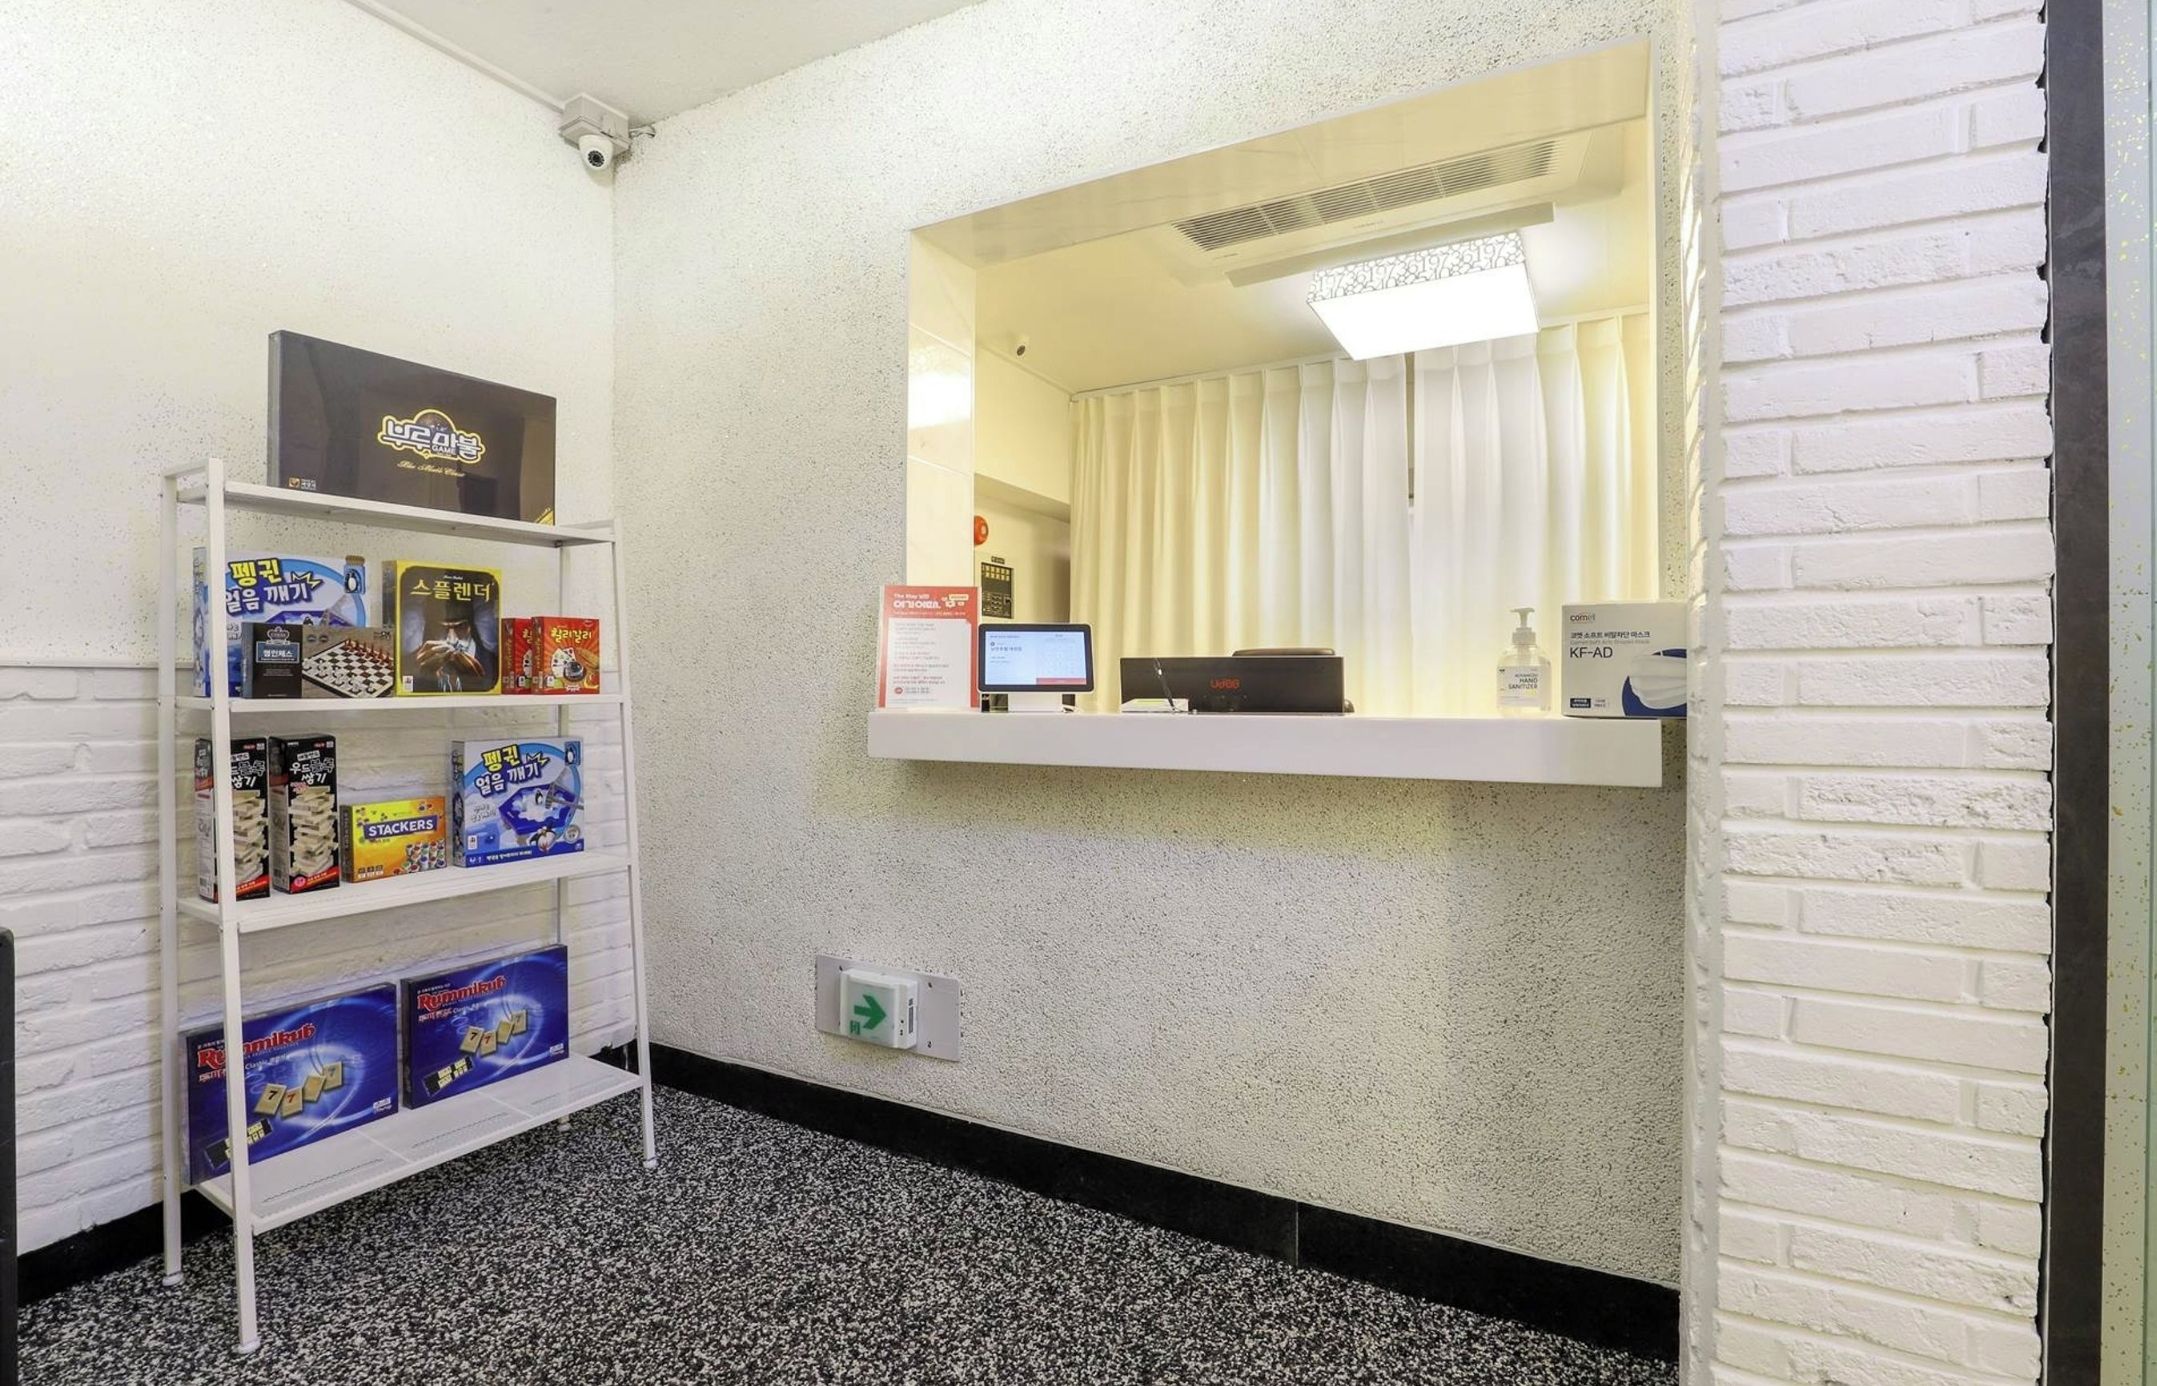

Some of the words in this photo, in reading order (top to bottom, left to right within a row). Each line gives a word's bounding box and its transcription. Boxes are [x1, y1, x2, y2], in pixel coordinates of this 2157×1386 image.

[382, 419, 482, 460] 부루마불
[431, 444, 457, 456] GAME
[229, 560, 282, 587] 펭귄
[263, 584, 309, 602] 깨기
[409, 578, 491, 602] 스플렌더
[1569, 646, 1613, 659] KF-AD
[230, 760, 266, 777] 드블록
[482, 746, 520, 772] 펭귄
[475, 773, 504, 796] 얼음
[506, 762, 539, 781] 깨기
[368, 819, 434, 837] STACKERS
[417, 975, 508, 1012] Rummikub
[268, 1090, 278, 1101] 7
